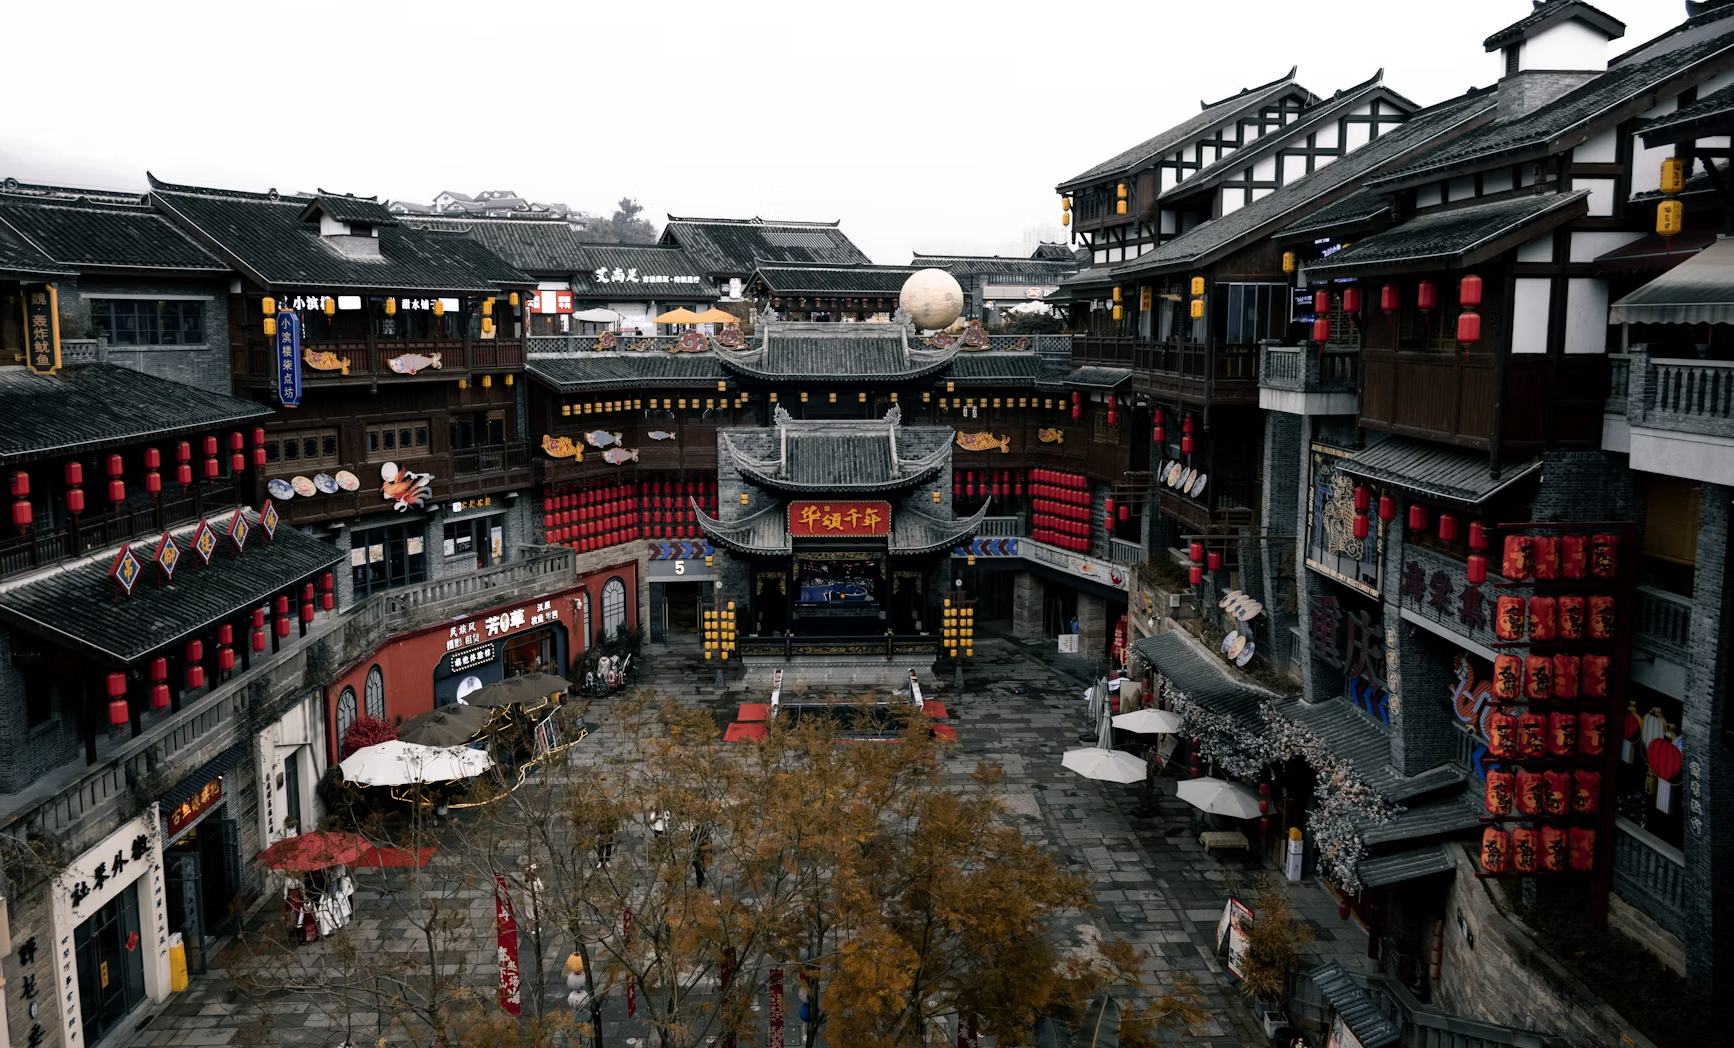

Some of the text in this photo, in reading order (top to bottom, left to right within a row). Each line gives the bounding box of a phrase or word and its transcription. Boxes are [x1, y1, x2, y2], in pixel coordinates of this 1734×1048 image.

[596, 267, 640, 284] 艾尚足
[281, 318, 294, 399] 小滨楼柒点坊
[675, 560, 685, 575] 5
[449, 621, 476, 638] 民族风
